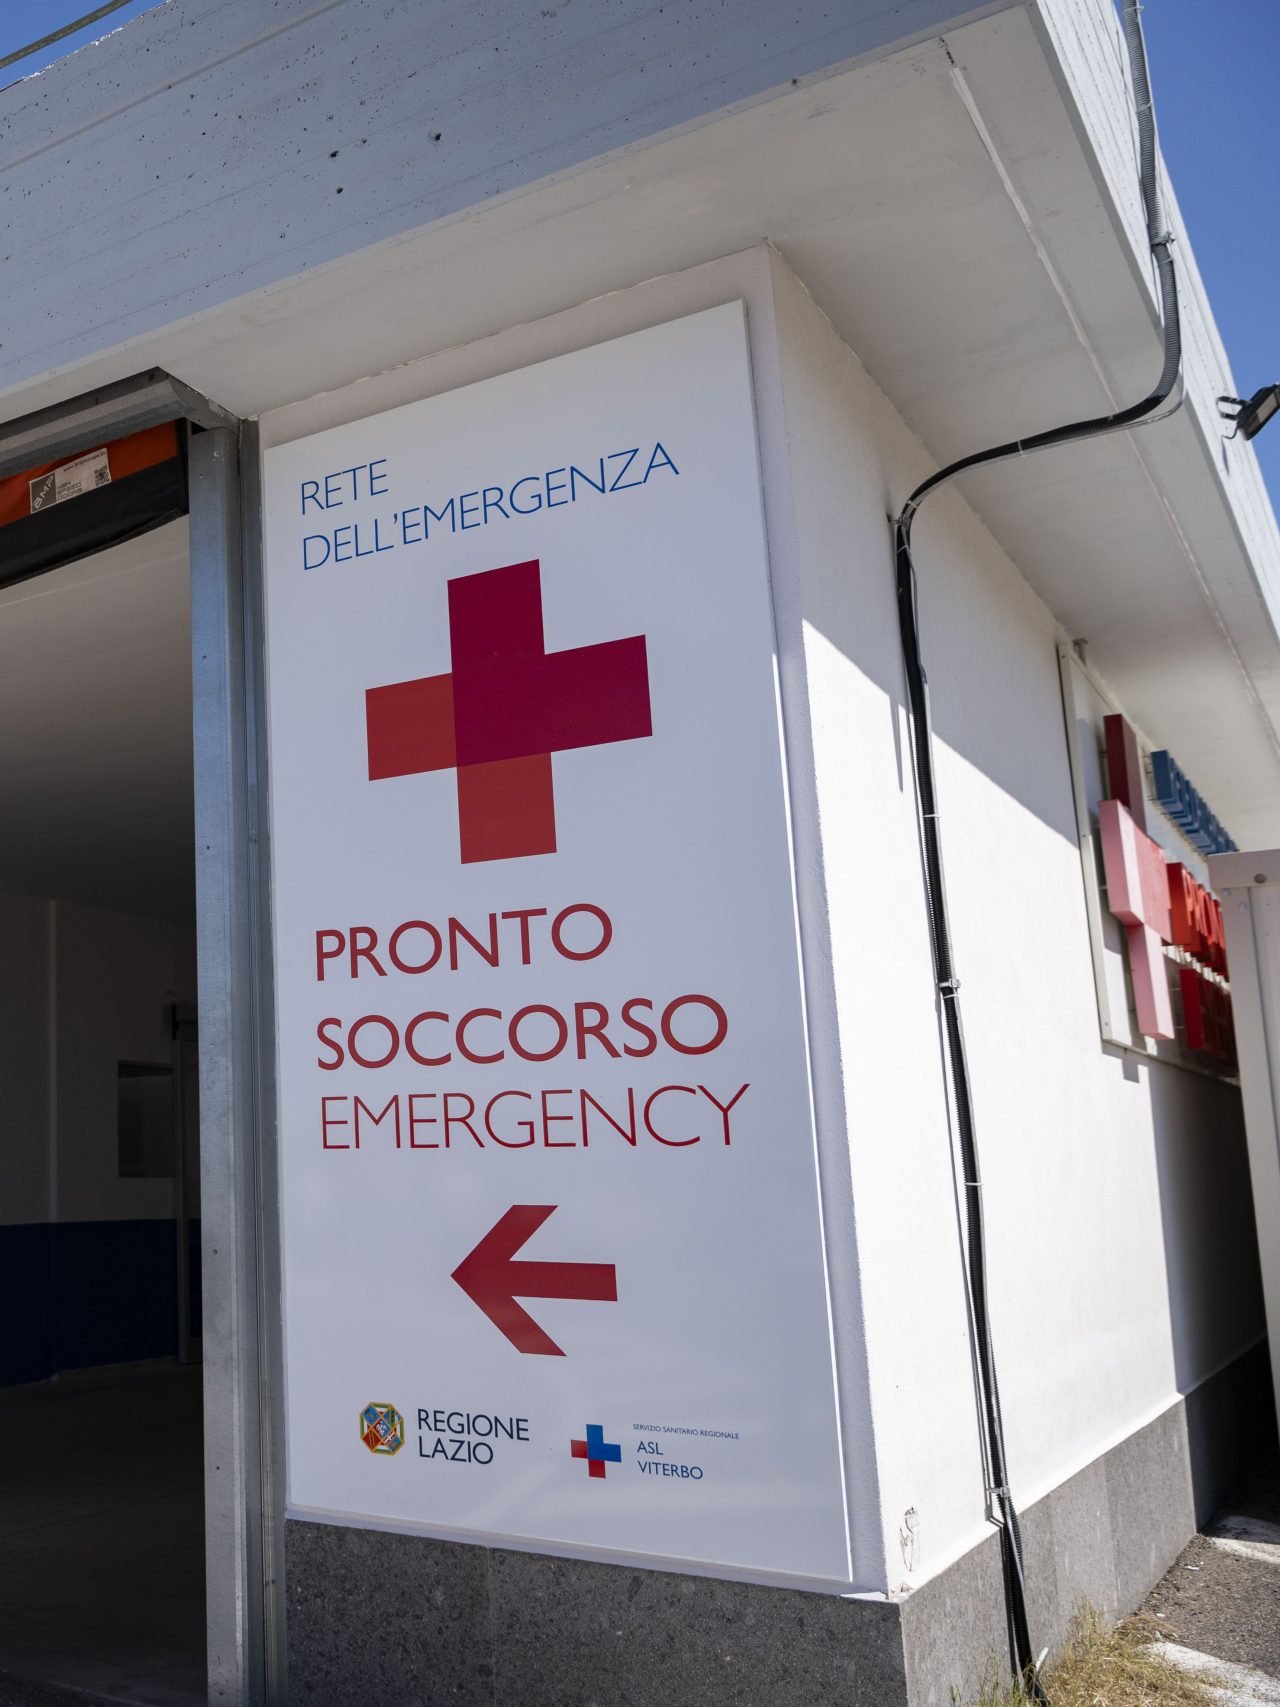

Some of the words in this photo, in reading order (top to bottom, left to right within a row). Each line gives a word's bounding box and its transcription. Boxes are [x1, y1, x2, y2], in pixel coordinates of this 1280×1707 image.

[33, 475, 54, 509] BMP
[301, 459, 389, 515] RETE
[303, 442, 680, 570] DELL'EMERGENZA
[315, 903, 613, 982] PRONTO
[316, 993, 728, 1071] SOCCORSO
[321, 1083, 751, 1149] EMERGENCY
[418, 1408, 530, 1441] REGIONE
[632, 1423, 662, 1433] SERVIZIO
[662, 1426, 699, 1437] SANITARIO
[700, 1429, 740, 1440] REGIONALE
[419, 1435, 494, 1465] LAZIO
[637, 1440, 664, 1455] ASL
[638, 1460, 704, 1480] VITERBO
